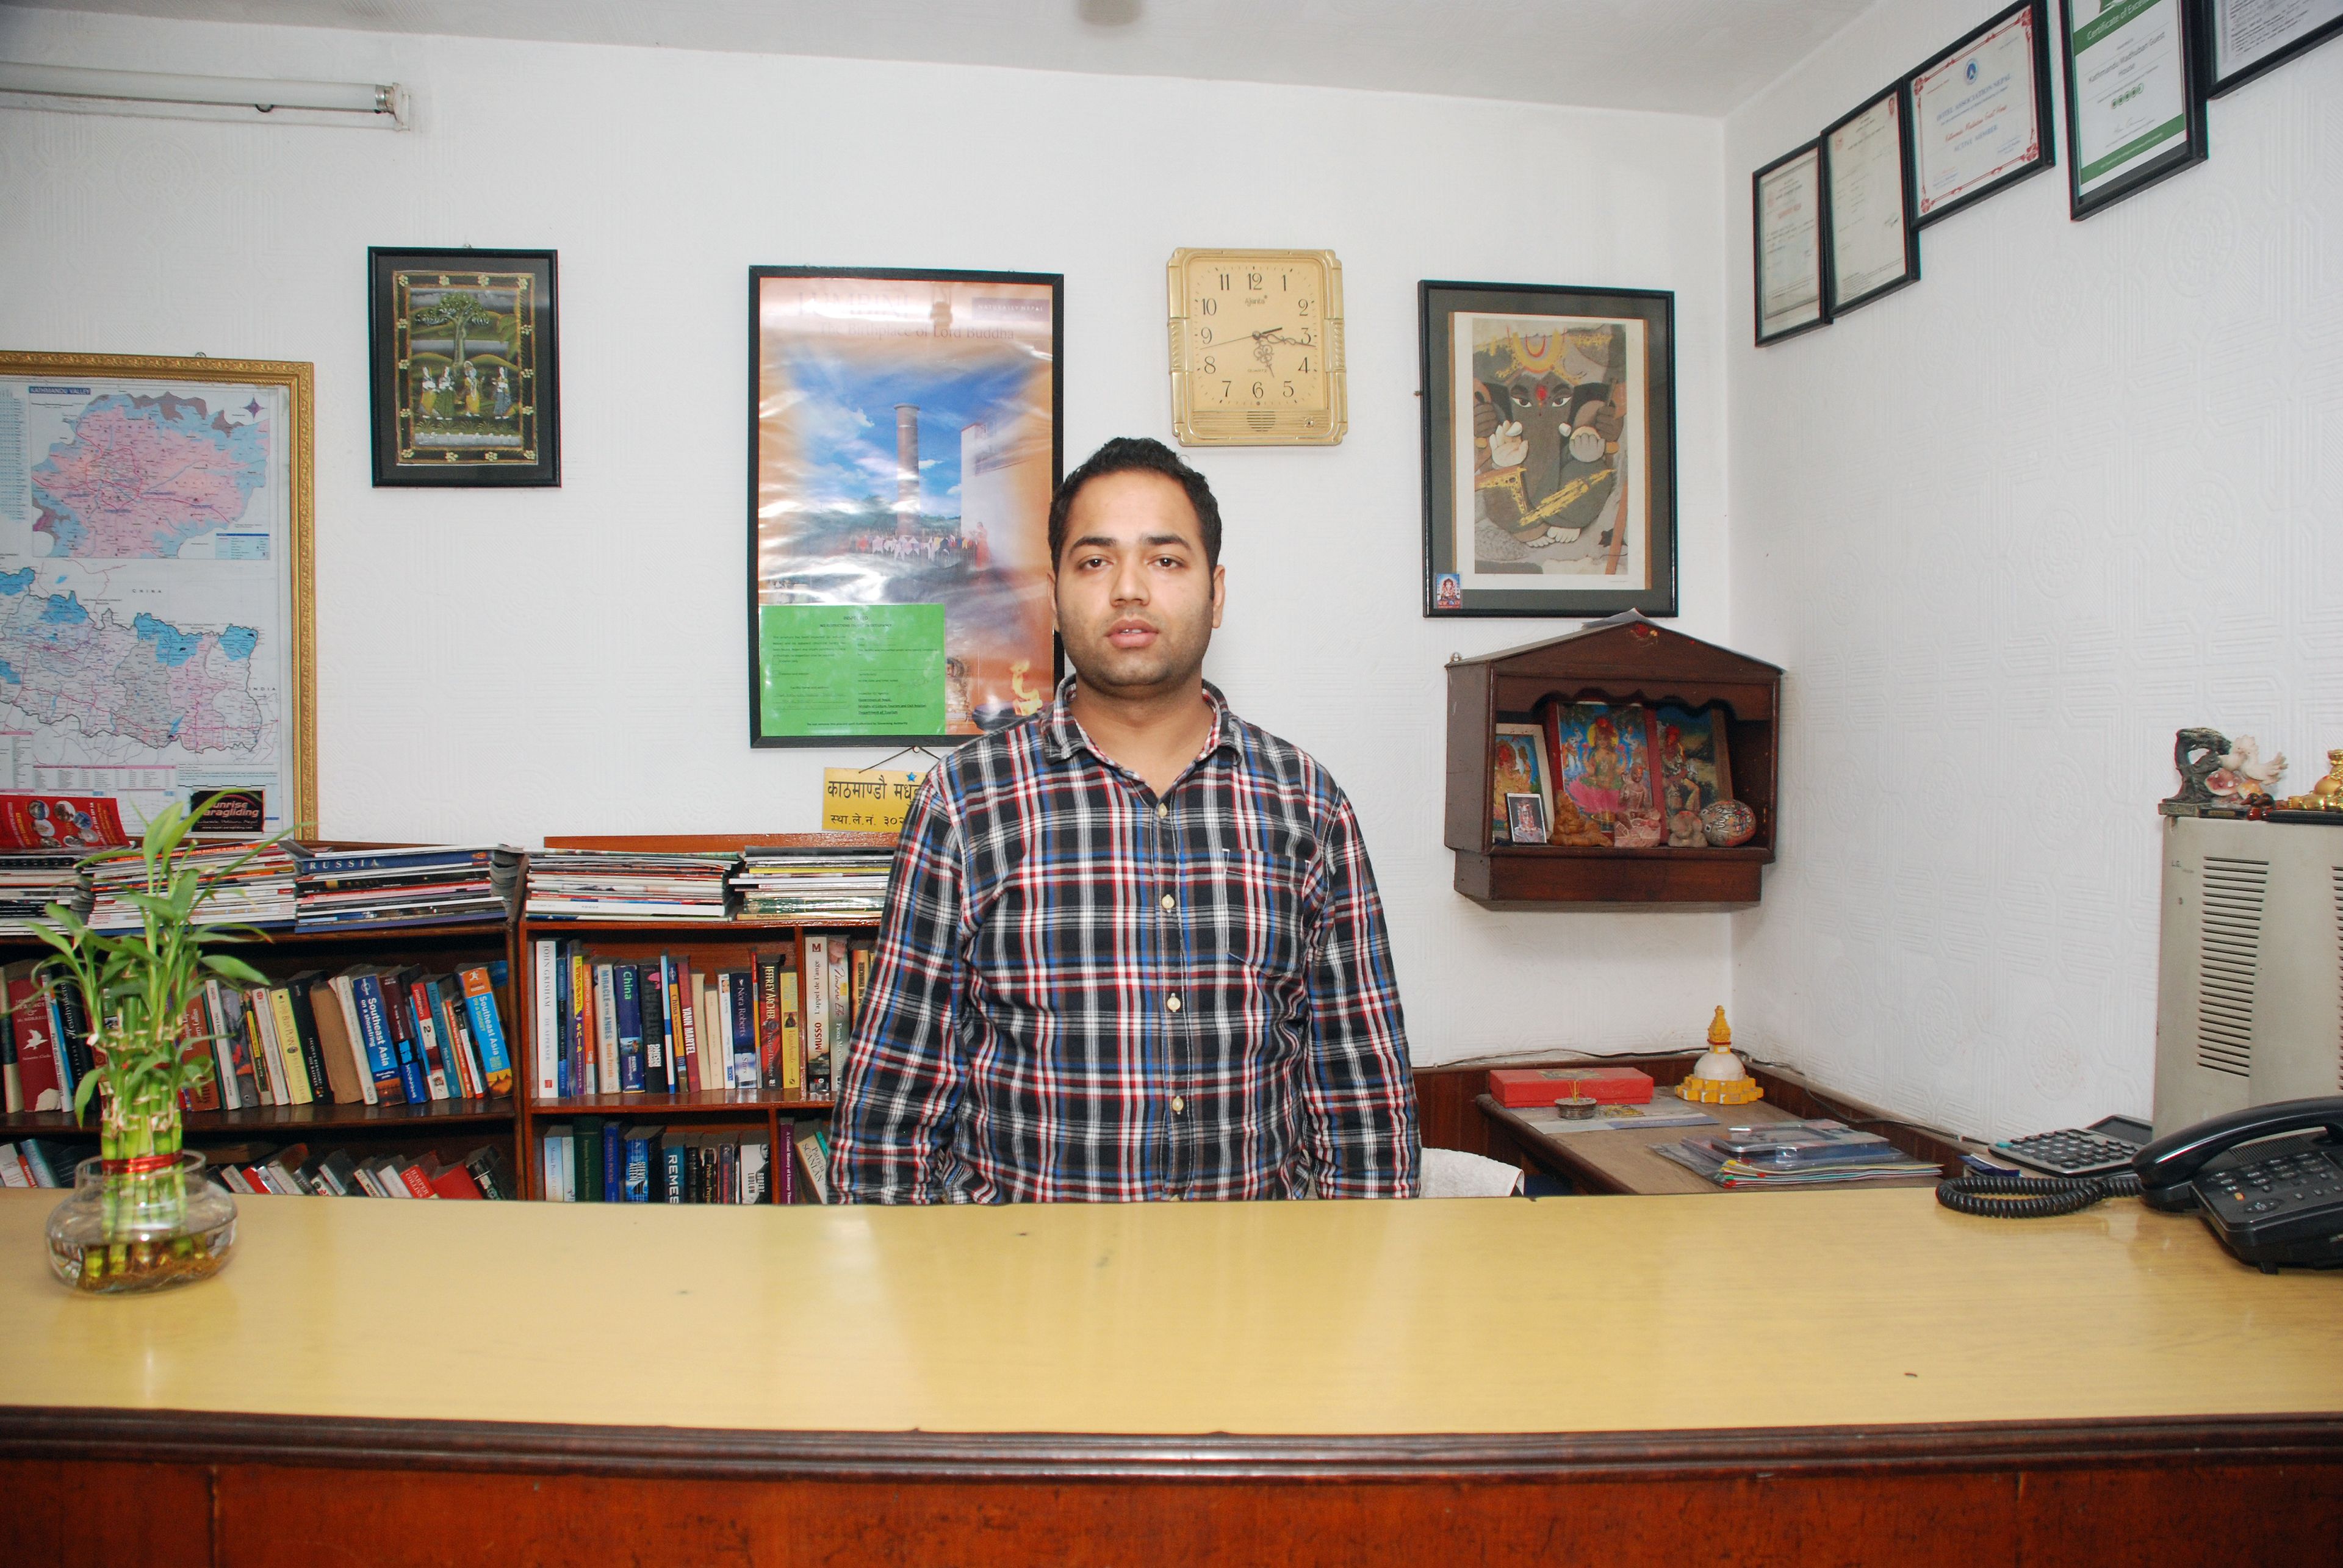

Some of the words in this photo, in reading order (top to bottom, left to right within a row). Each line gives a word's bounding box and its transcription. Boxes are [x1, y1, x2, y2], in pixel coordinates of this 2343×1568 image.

[1220, 274, 1229, 290] 11
[1247, 273, 1262, 290] 12
[1282, 275, 1287, 291] 1
[1201, 298, 1217, 315] 10
[1298, 299, 1309, 316] 2
[821, 323, 841, 335] The
[848, 325, 913, 340] Birthplace
[915, 325, 929, 337] of
[933, 326, 962, 338] Lord
[966, 327, 1015, 340] Buddha
[1201, 327, 1212, 344] 9
[1301, 327, 1311, 345] 3
[1204, 356, 1216, 374] 8
[1298, 357, 1310, 373] 4
[1222, 380, 1232, 397] 7
[1252, 381, 1264, 398] 6
[1283, 381, 1294, 397] 5
[203, 808, 259, 818] aragliding
[309, 858, 380, 869] RUSSIA
[602, 969, 611, 1002] MIRACLE
[623, 971, 633, 1001] China
[763, 966, 775, 992] JEFFREY
[815, 981, 820, 990] de
[414, 989, 425, 1017] patterson
[737, 987, 746, 1005] Nora
[682, 1006, 693, 1026] YANN
[766, 993, 776, 1020] ARCHER
[361, 999, 367, 1008] on
[364, 1013, 376, 1048] shoestring
[368, 998, 386, 1045] Southeast
[378, 1047, 390, 1066] Asia
[479, 996, 494, 1037] Southeast
[489, 1038, 499, 1056] Asia
[603, 1016, 612, 1040] ANDES
[738, 1008, 747, 1037] Roberts
[308, 1037, 317, 1059] JACQUES
[684, 1027, 696, 1056] MARTEL
[653, 1043, 662, 1067] RISING
[638, 1160, 647, 1179] STEVE
[803, 1143, 824, 1182] SCANLAN
[409, 1168, 430, 1195] HARPER
[628, 1163, 638, 1182] ALTEN
[668, 1154, 679, 1203] REMES
[404, 1173, 425, 1197] COLLINS
[756, 1172, 765, 1193] ROBERT
